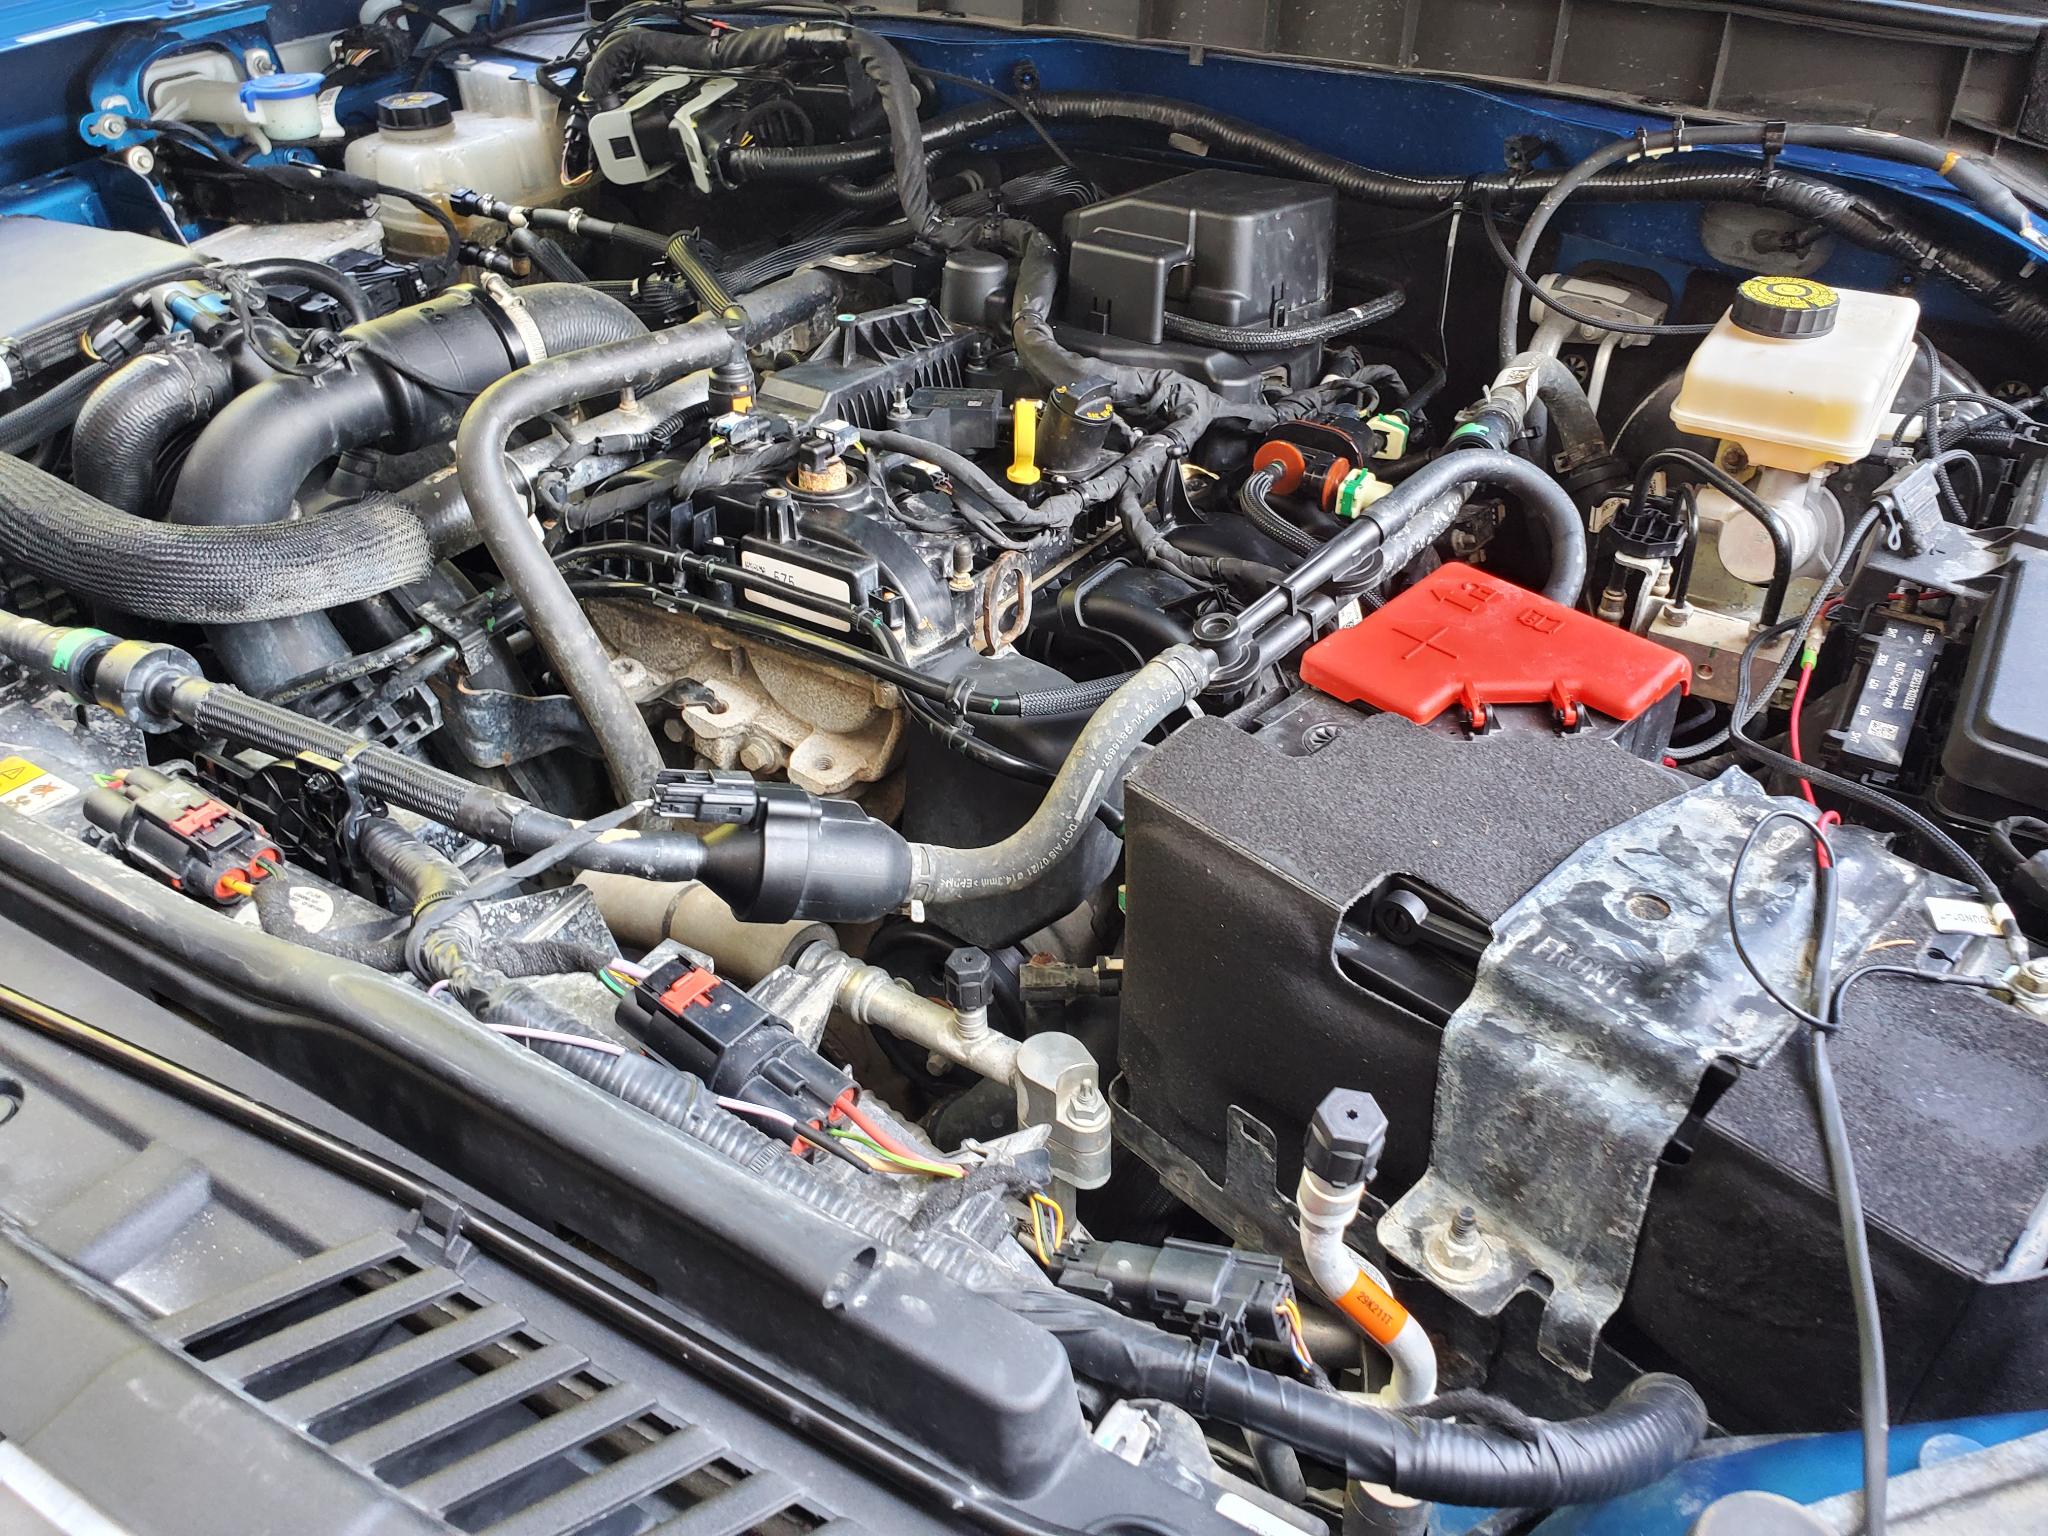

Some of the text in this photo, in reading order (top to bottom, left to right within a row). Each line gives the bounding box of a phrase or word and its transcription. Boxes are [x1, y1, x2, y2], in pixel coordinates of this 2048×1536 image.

[1062, 823, 1079, 845] DOT
[1026, 857, 1050, 877] 07/21
[1531, 936, 1630, 996] FRONT
